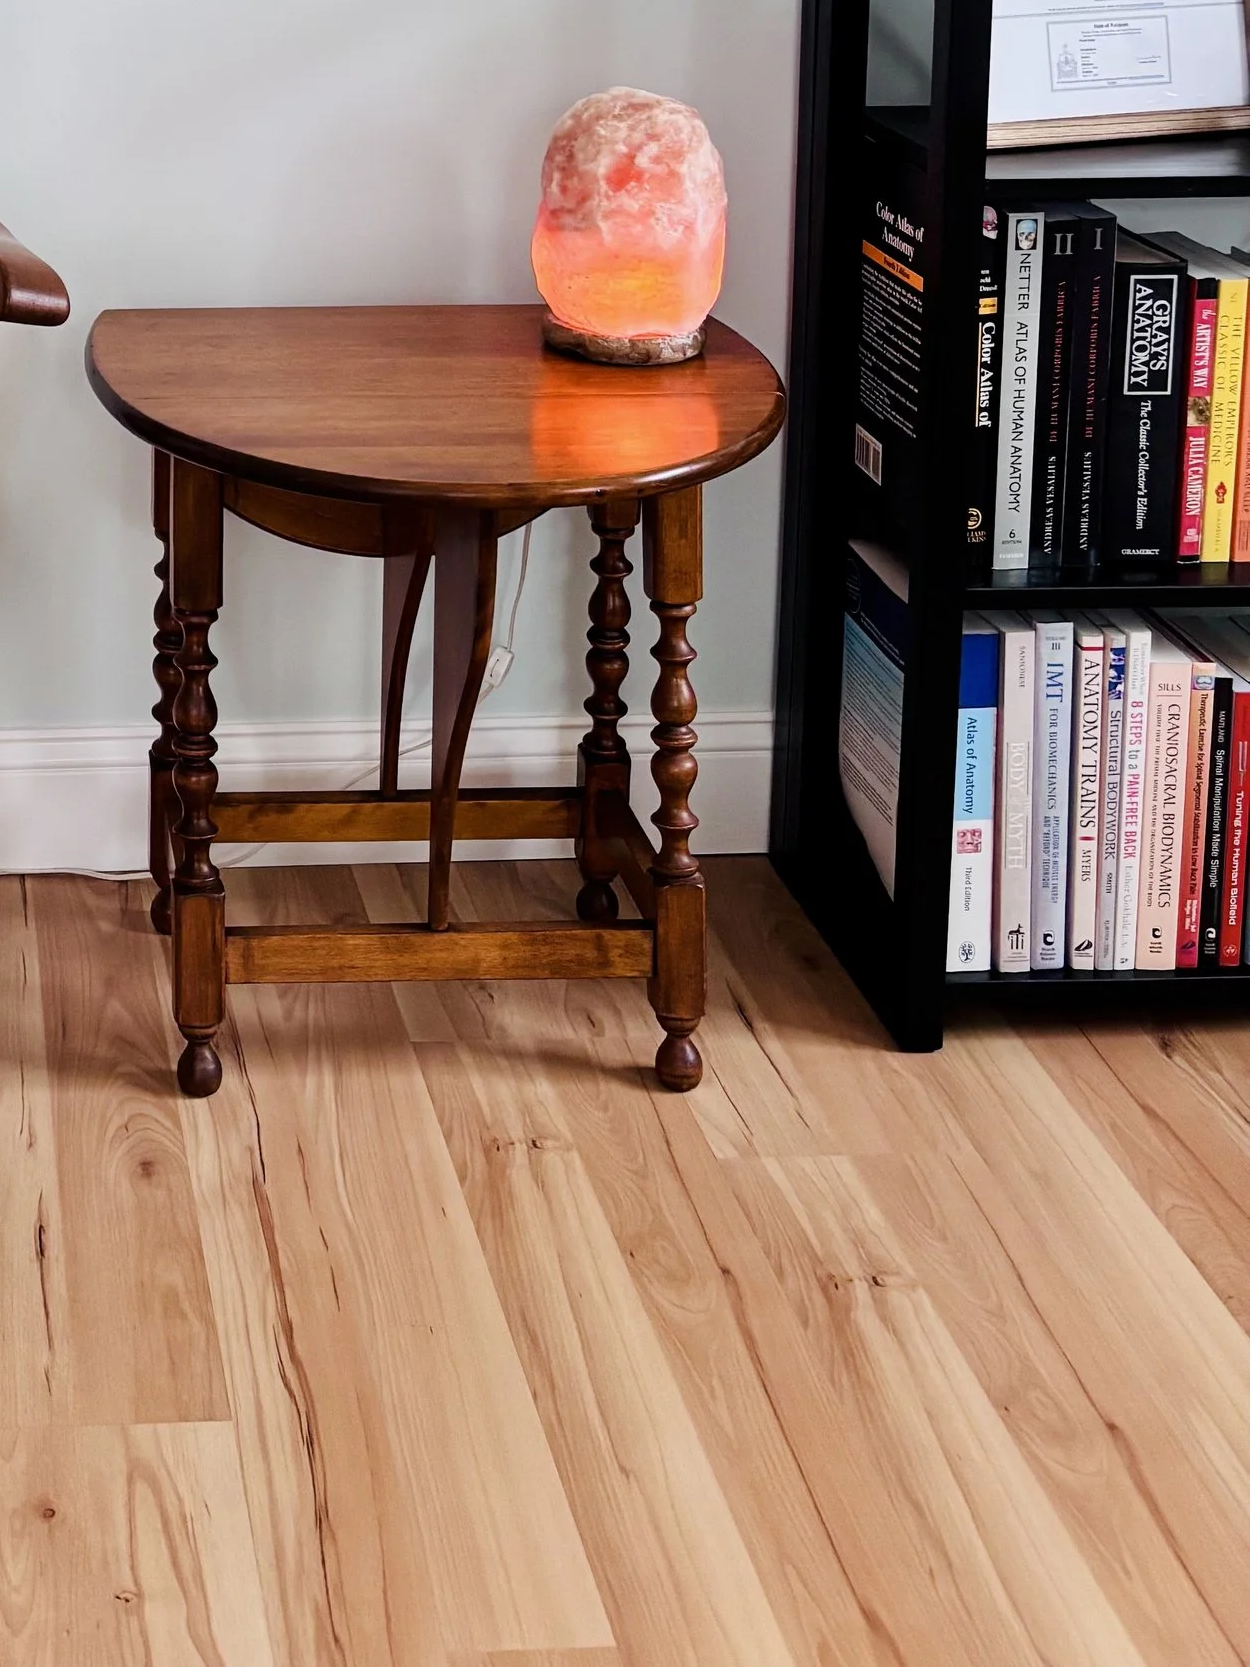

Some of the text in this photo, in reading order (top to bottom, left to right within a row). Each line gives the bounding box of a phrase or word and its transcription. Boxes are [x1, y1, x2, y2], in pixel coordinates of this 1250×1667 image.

[876, 201, 925, 242] Color Atlas of
[881, 226, 915, 262] Anatomy
[983, 321, 996, 364] Color
[1131, 283, 1154, 387] ANATOMY
[1151, 299, 1171, 371] GRAY'S
[1195, 323, 1212, 366] ARTIST'S
[981, 368, 994, 408] Atlas
[1009, 253, 1031, 513] NETTER ATLAS OF HUMAN ANATOMY
[1194, 367, 1209, 389] WAY
[1212, 315, 1230, 463] CLASSIC OF MEDICINE
[1225, 316, 1242, 467] THE YELLOW EMPEROR'S
[980, 412, 992, 427] of
[1136, 399, 1152, 530] The Classic Collector's Edition
[1189, 436, 1206, 464] JULIA
[1186, 467, 1205, 516] CAMERON
[1008, 528, 1017, 539] 6
[1132, 700, 1143, 708] 8
[1158, 683, 1182, 691] SILLS
[1199, 693, 1208, 728] Therapeutic
[1046, 662, 1064, 810] IMT FOR BIOMECHANICS
[1080, 658, 1100, 828] ANATOMY TRAINS
[1130, 712, 1143, 746] STEPS
[962, 717, 978, 814] Atlas of Anatomy
[1010, 742, 1026, 792] BODY
[1129, 749, 1141, 760] to
[1105, 710, 1121, 861] Structural BODYWORK
[1126, 773, 1140, 827] PAIN-FREE
[1159, 703, 1181, 908] CRANIOSACRAL BIODYNAMICS
[1009, 813, 1024, 869] MYTH
[1210, 749, 1225, 888] Spinal Manipulation Made Simple
[1082, 849, 1092, 882] MYERS
[1124, 831, 1137, 859] BACK
[1229, 791, 1244, 926] Tuning the Human Biofield
[964, 867, 972, 912] Third Edition
